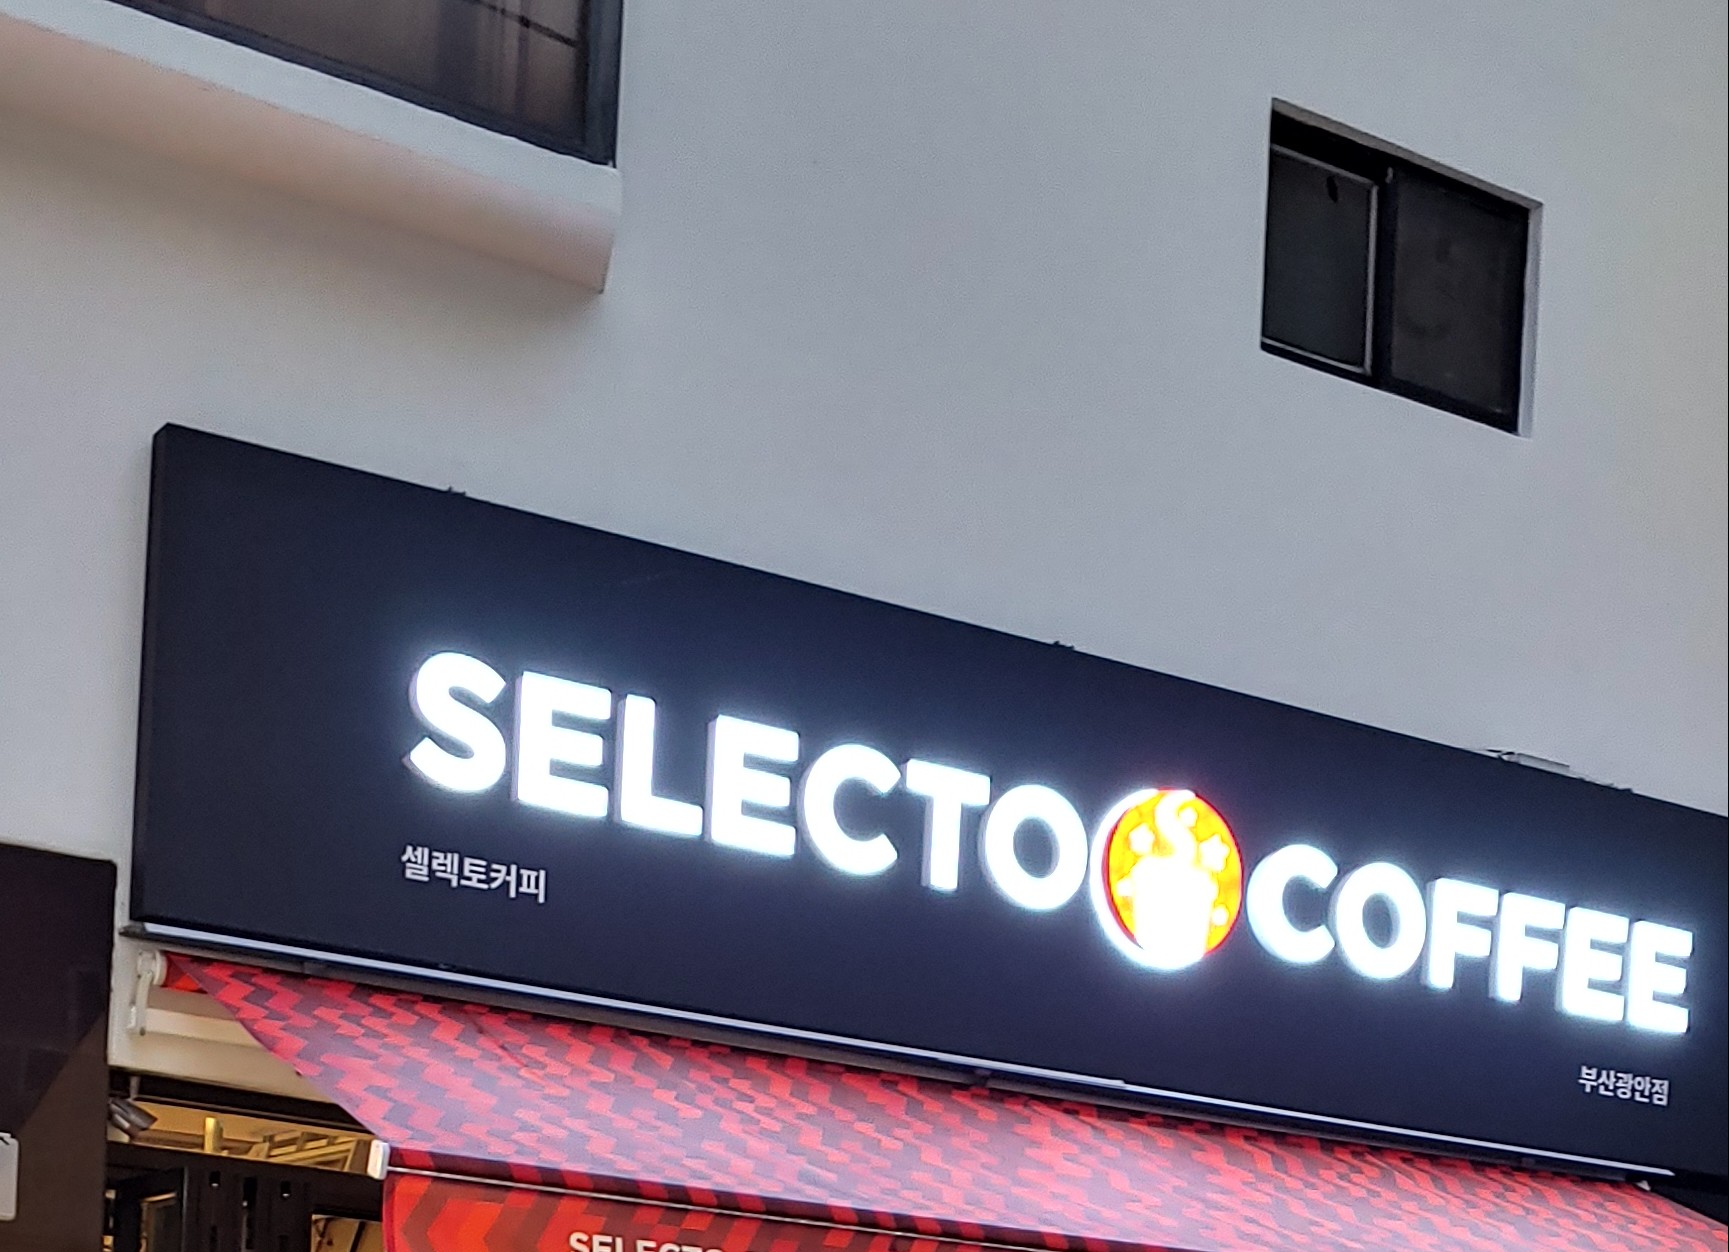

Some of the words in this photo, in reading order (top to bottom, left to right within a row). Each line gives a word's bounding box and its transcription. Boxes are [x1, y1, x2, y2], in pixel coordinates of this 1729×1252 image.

[402, 650, 1089, 911] SELECTO
[1246, 843, 1695, 1034] COFFEE
[400, 844, 546, 904] 셀렉토커피
[1578, 1065, 1669, 1106] 부산광안점
